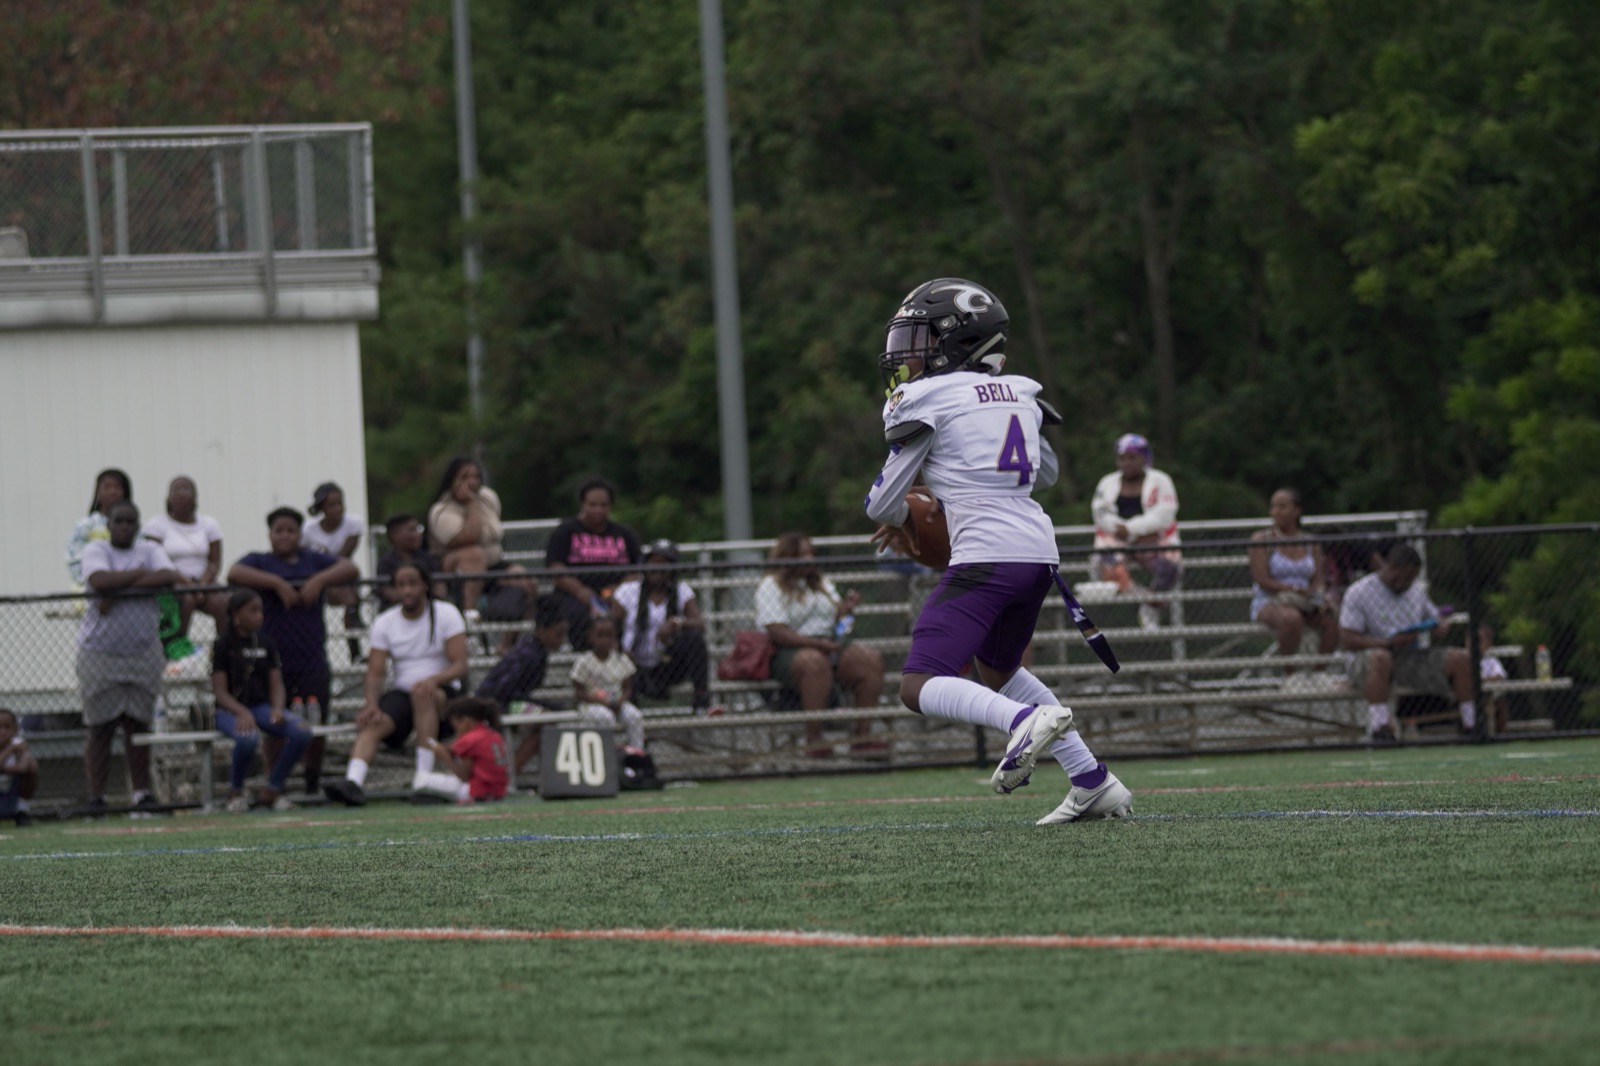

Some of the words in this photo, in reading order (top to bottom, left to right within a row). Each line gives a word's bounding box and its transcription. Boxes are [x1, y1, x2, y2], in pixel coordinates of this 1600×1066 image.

[974, 383, 1019, 403] BELL
[996, 413, 1033, 486] 4
[556, 731, 606, 786] 40
